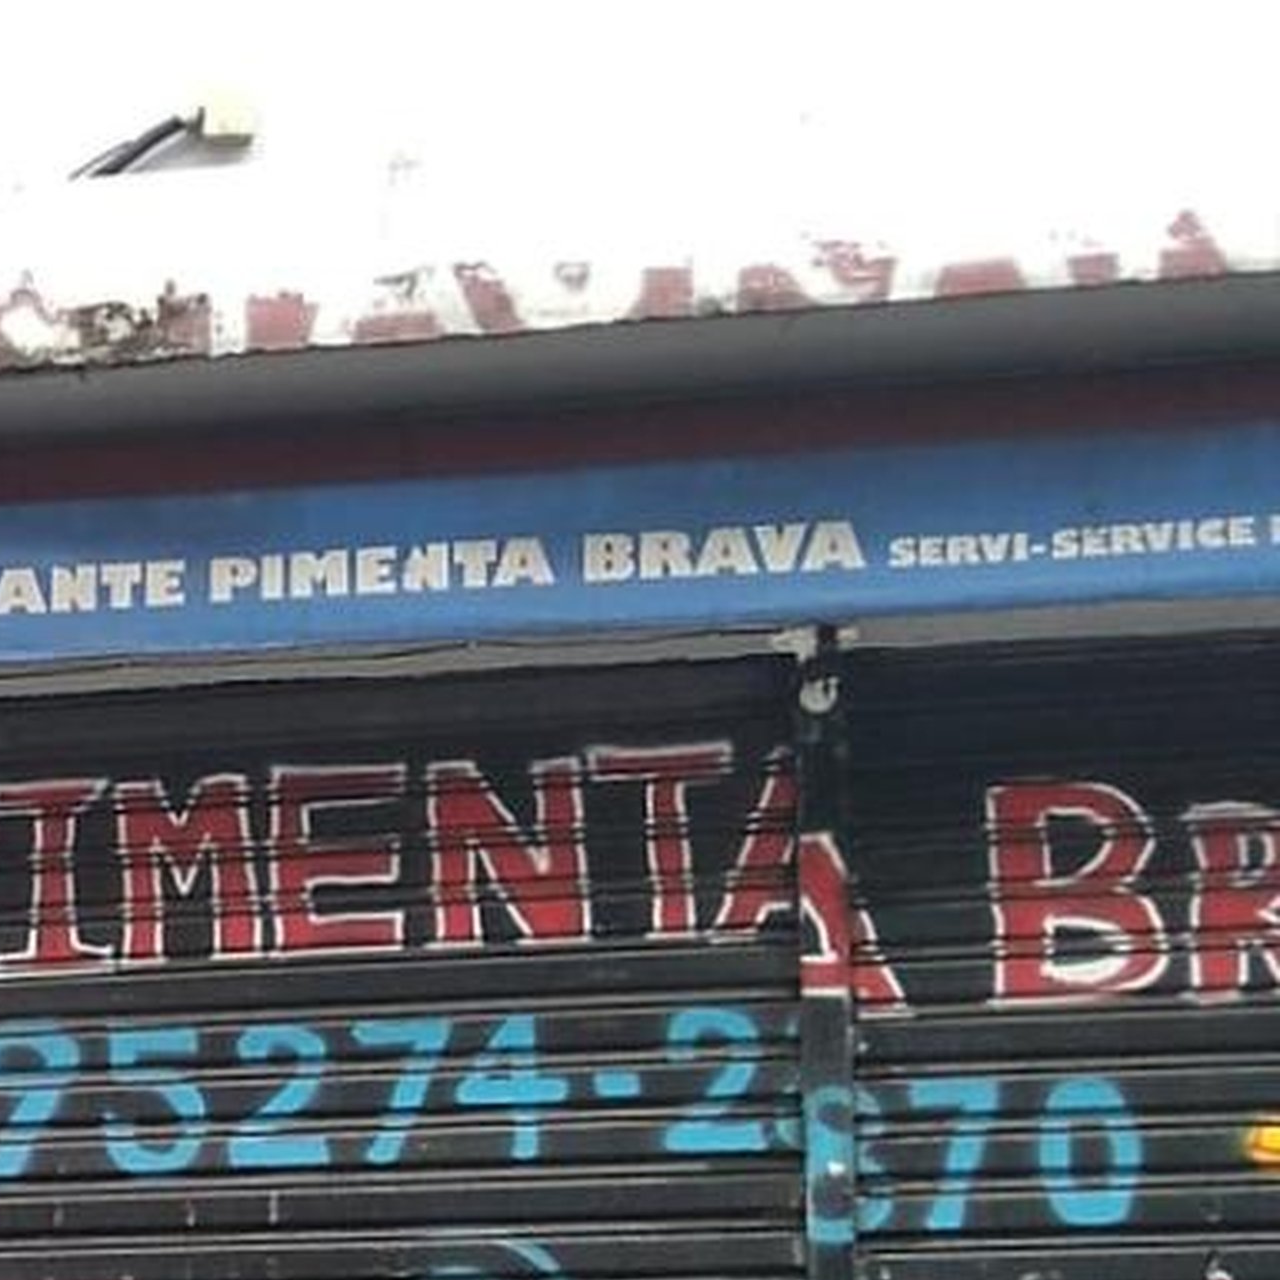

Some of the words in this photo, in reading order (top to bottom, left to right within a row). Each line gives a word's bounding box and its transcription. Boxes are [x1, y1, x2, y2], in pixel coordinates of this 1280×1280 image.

[208, 537, 556, 603] PIMENTA
[582, 520, 865, 584] BRAVA
[887, 515, 1256, 568] SERVI-SERVICE
